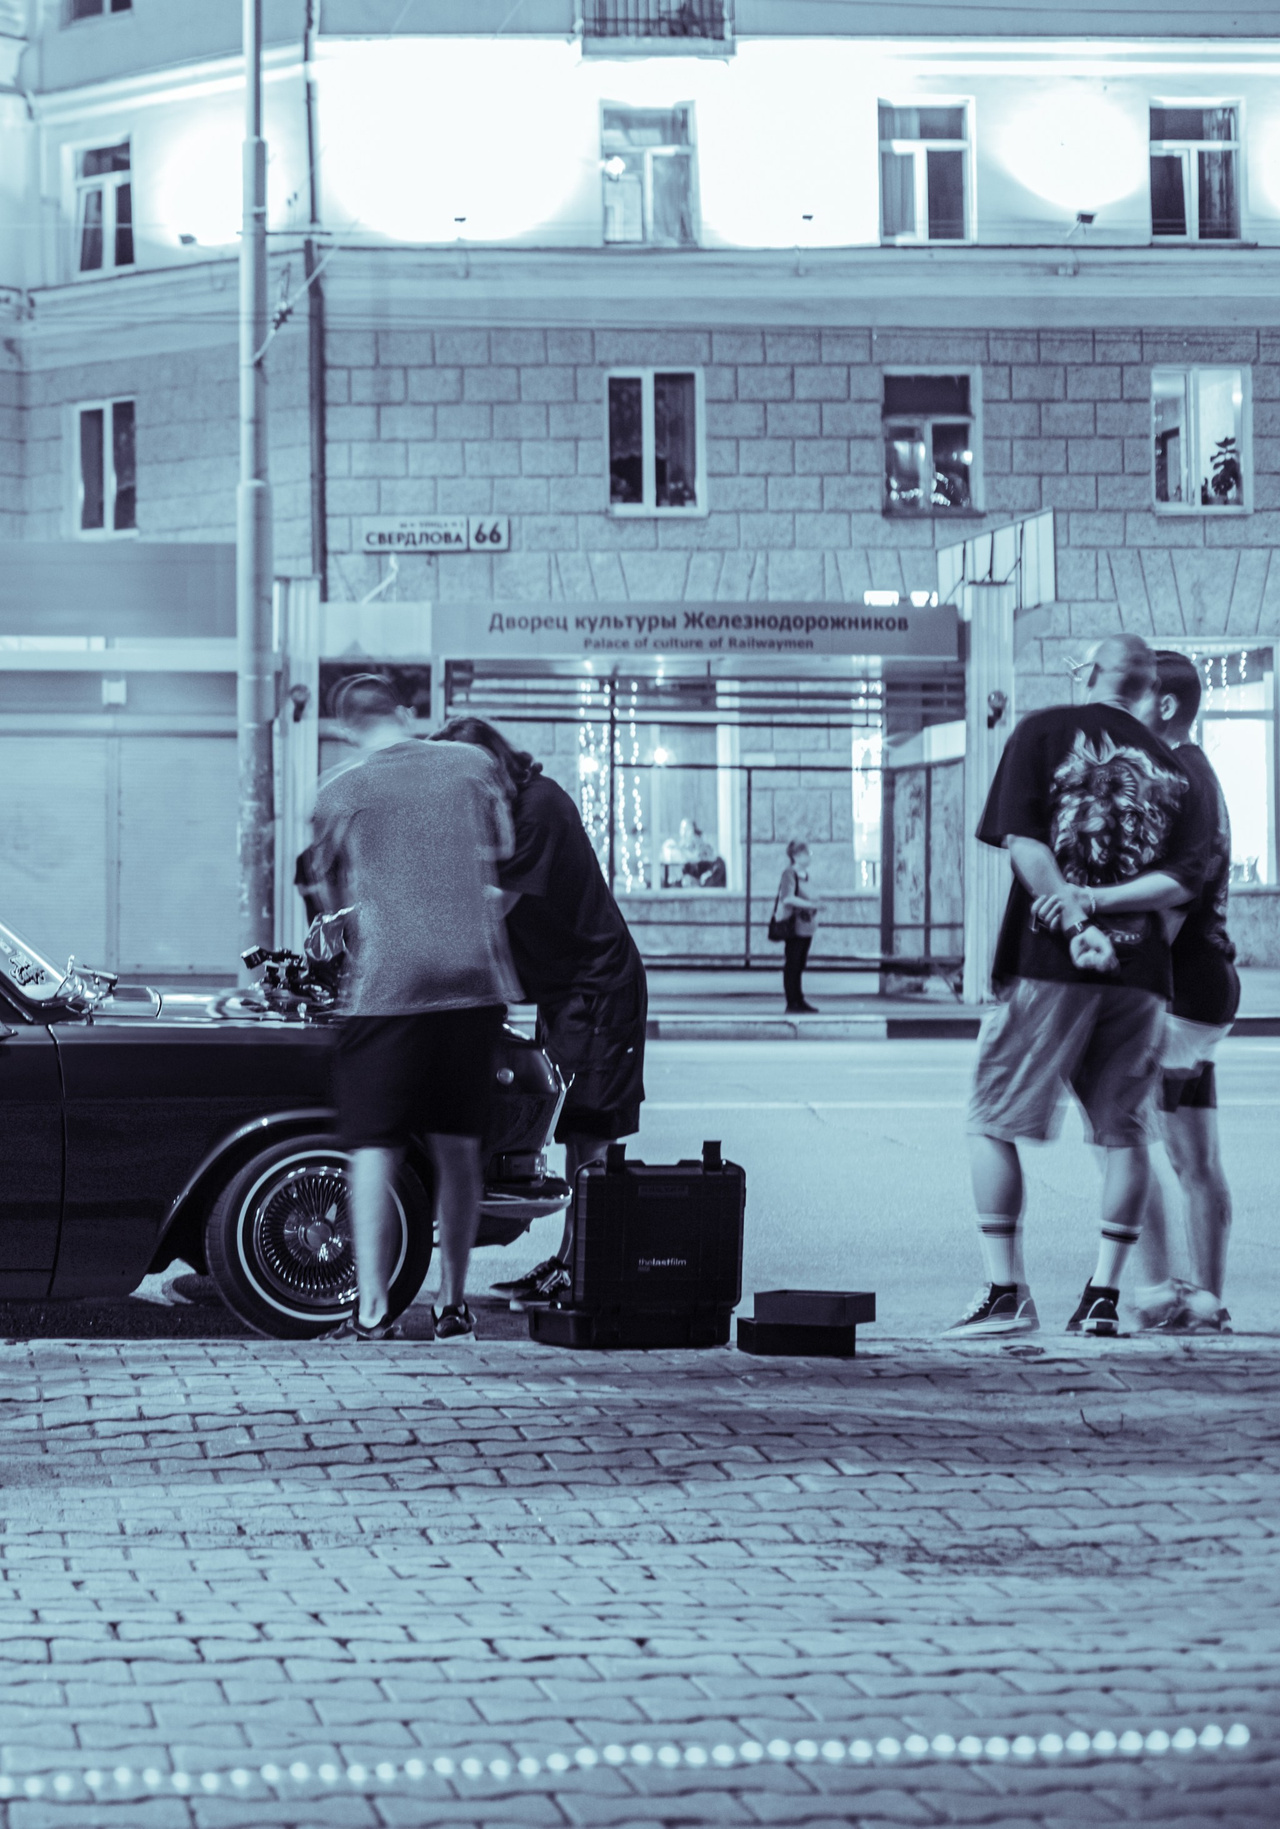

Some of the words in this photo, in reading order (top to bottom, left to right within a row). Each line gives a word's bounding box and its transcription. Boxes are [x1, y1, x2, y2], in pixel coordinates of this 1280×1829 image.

[365, 531, 463, 547] СВЕРДЛОВА
[474, 522, 502, 544] 66
[489, 612, 568, 634] Дворец
[575, 614, 677, 634] культуры
[683, 611, 910, 634] Железнодорожников
[584, 637, 630, 649] Palace
[634, 637, 648, 649] of
[652, 637, 703, 649] culture
[709, 637, 722, 649] of
[728, 637, 814, 651] Railwaymen
